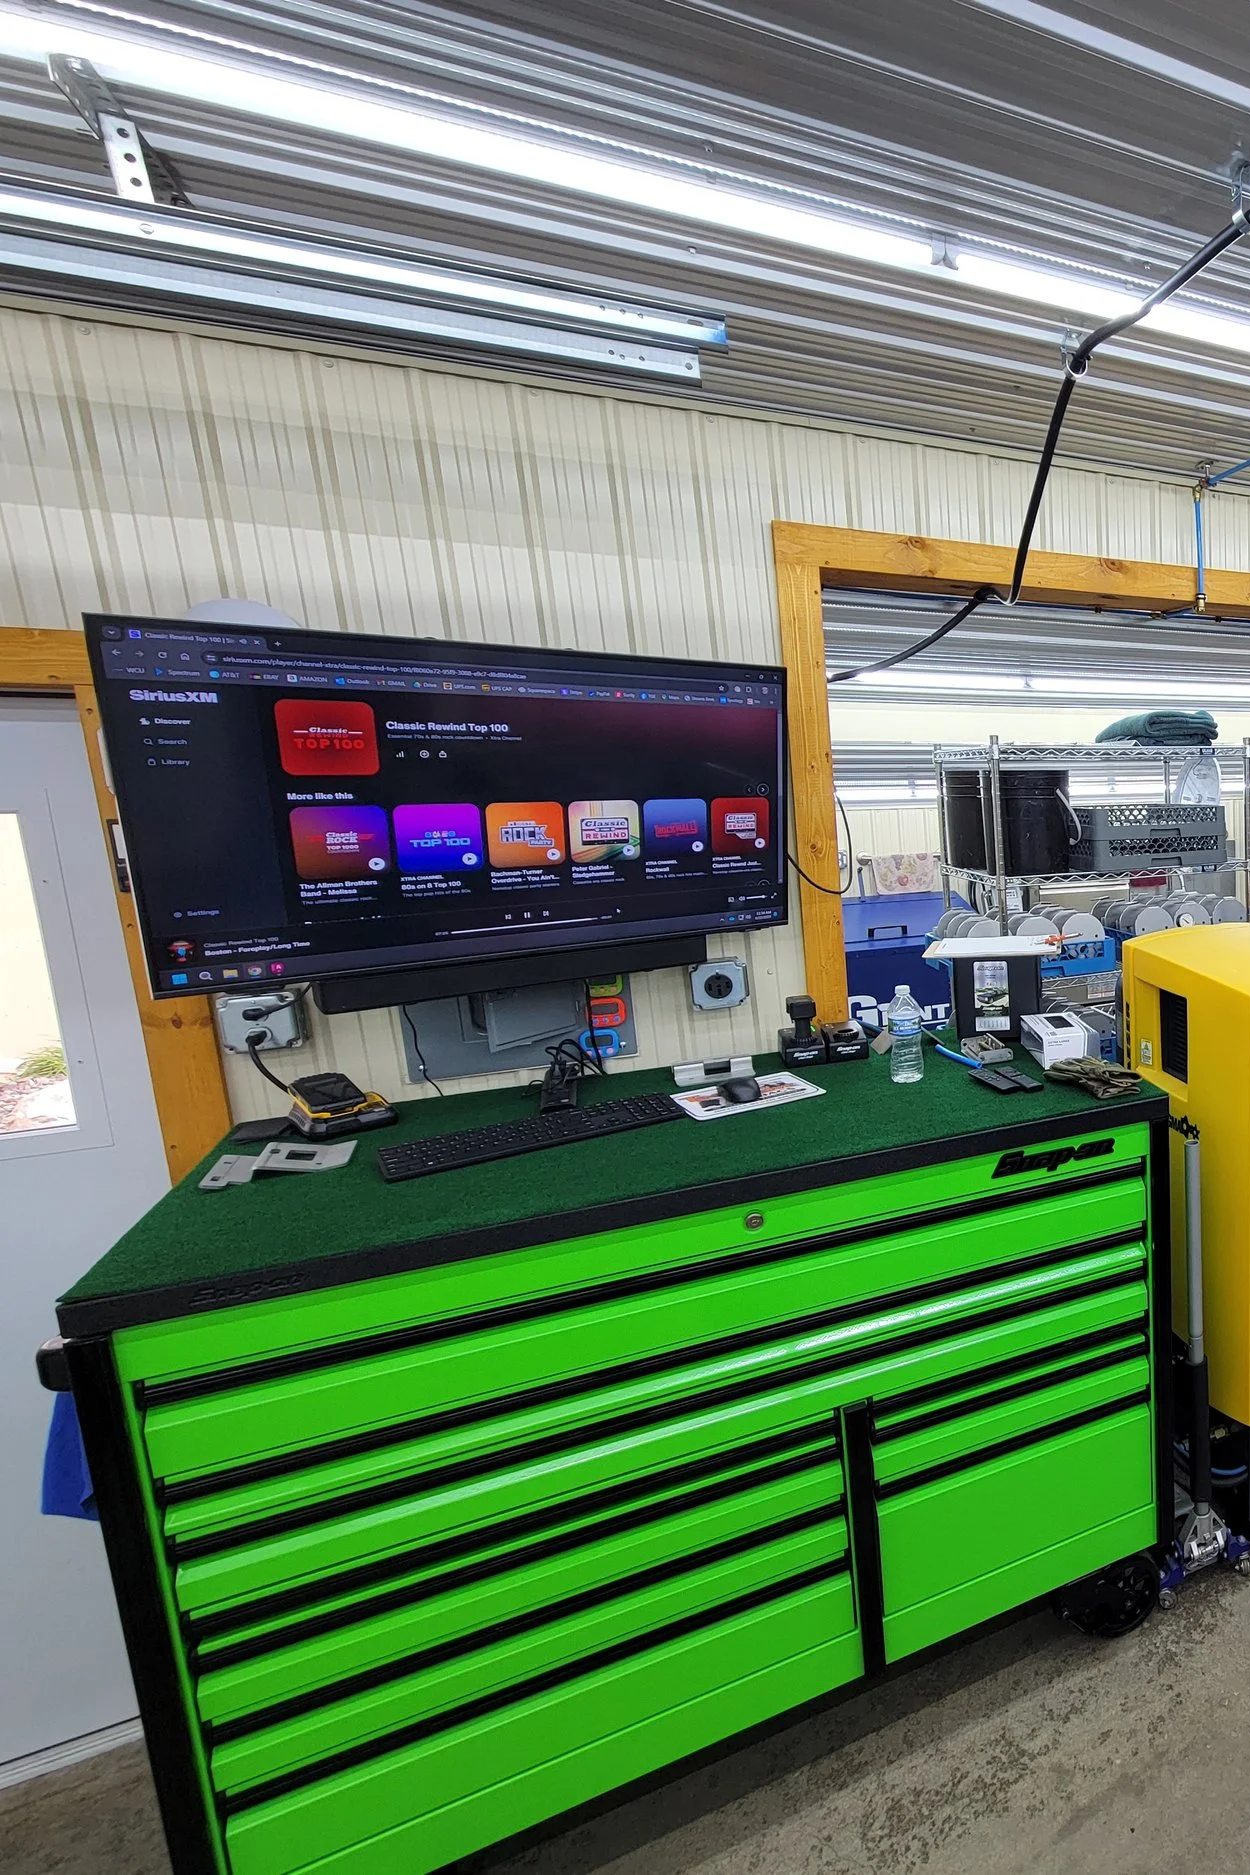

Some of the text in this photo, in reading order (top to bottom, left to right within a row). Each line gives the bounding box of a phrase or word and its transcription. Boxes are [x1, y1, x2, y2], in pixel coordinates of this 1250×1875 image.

[129, 688, 219, 704] SiriusXM
[154, 717, 192, 725] Discover
[385, 720, 509, 733] Classic Rewind Top 100
[293, 738, 365, 750] TOP 100
[161, 758, 191, 766] Library
[286, 791, 354, 801] More like this
[584, 820, 626, 828] Classic
[501, 826, 546, 842] ROCK
[585, 832, 627, 840] REWIND
[409, 837, 471, 848] TOP 100
[433, 881, 448, 889] Top
[448, 880, 462, 888] 100
[186, 909, 220, 917] Settings
[991, 1137, 1116, 1180] Snap-on
